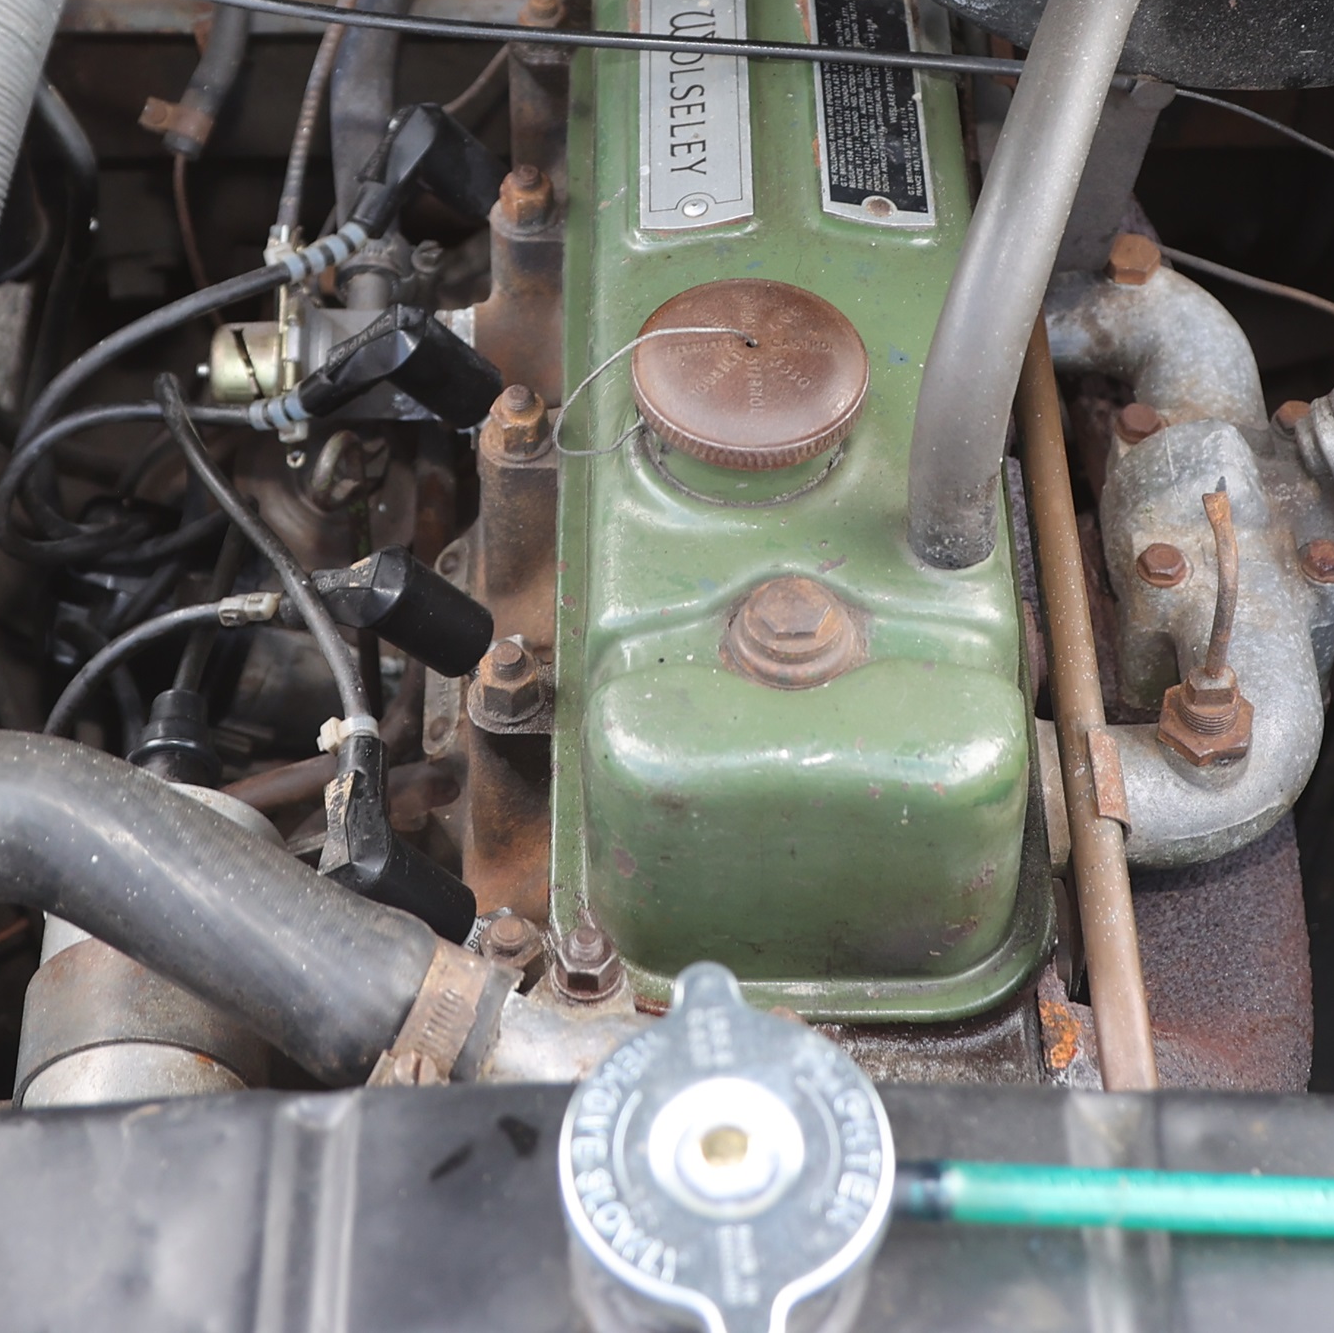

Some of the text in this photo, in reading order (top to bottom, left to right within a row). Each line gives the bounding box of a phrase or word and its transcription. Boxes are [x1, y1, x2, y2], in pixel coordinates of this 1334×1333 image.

[669, 8, 716, 175] WOLSELEY
[887, 93, 897, 123] WESLAKE
[829, 141, 838, 173] FOLLOWING
[326, 313, 393, 366] CHAMPION
[771, 337, 838, 356] CASTROL
